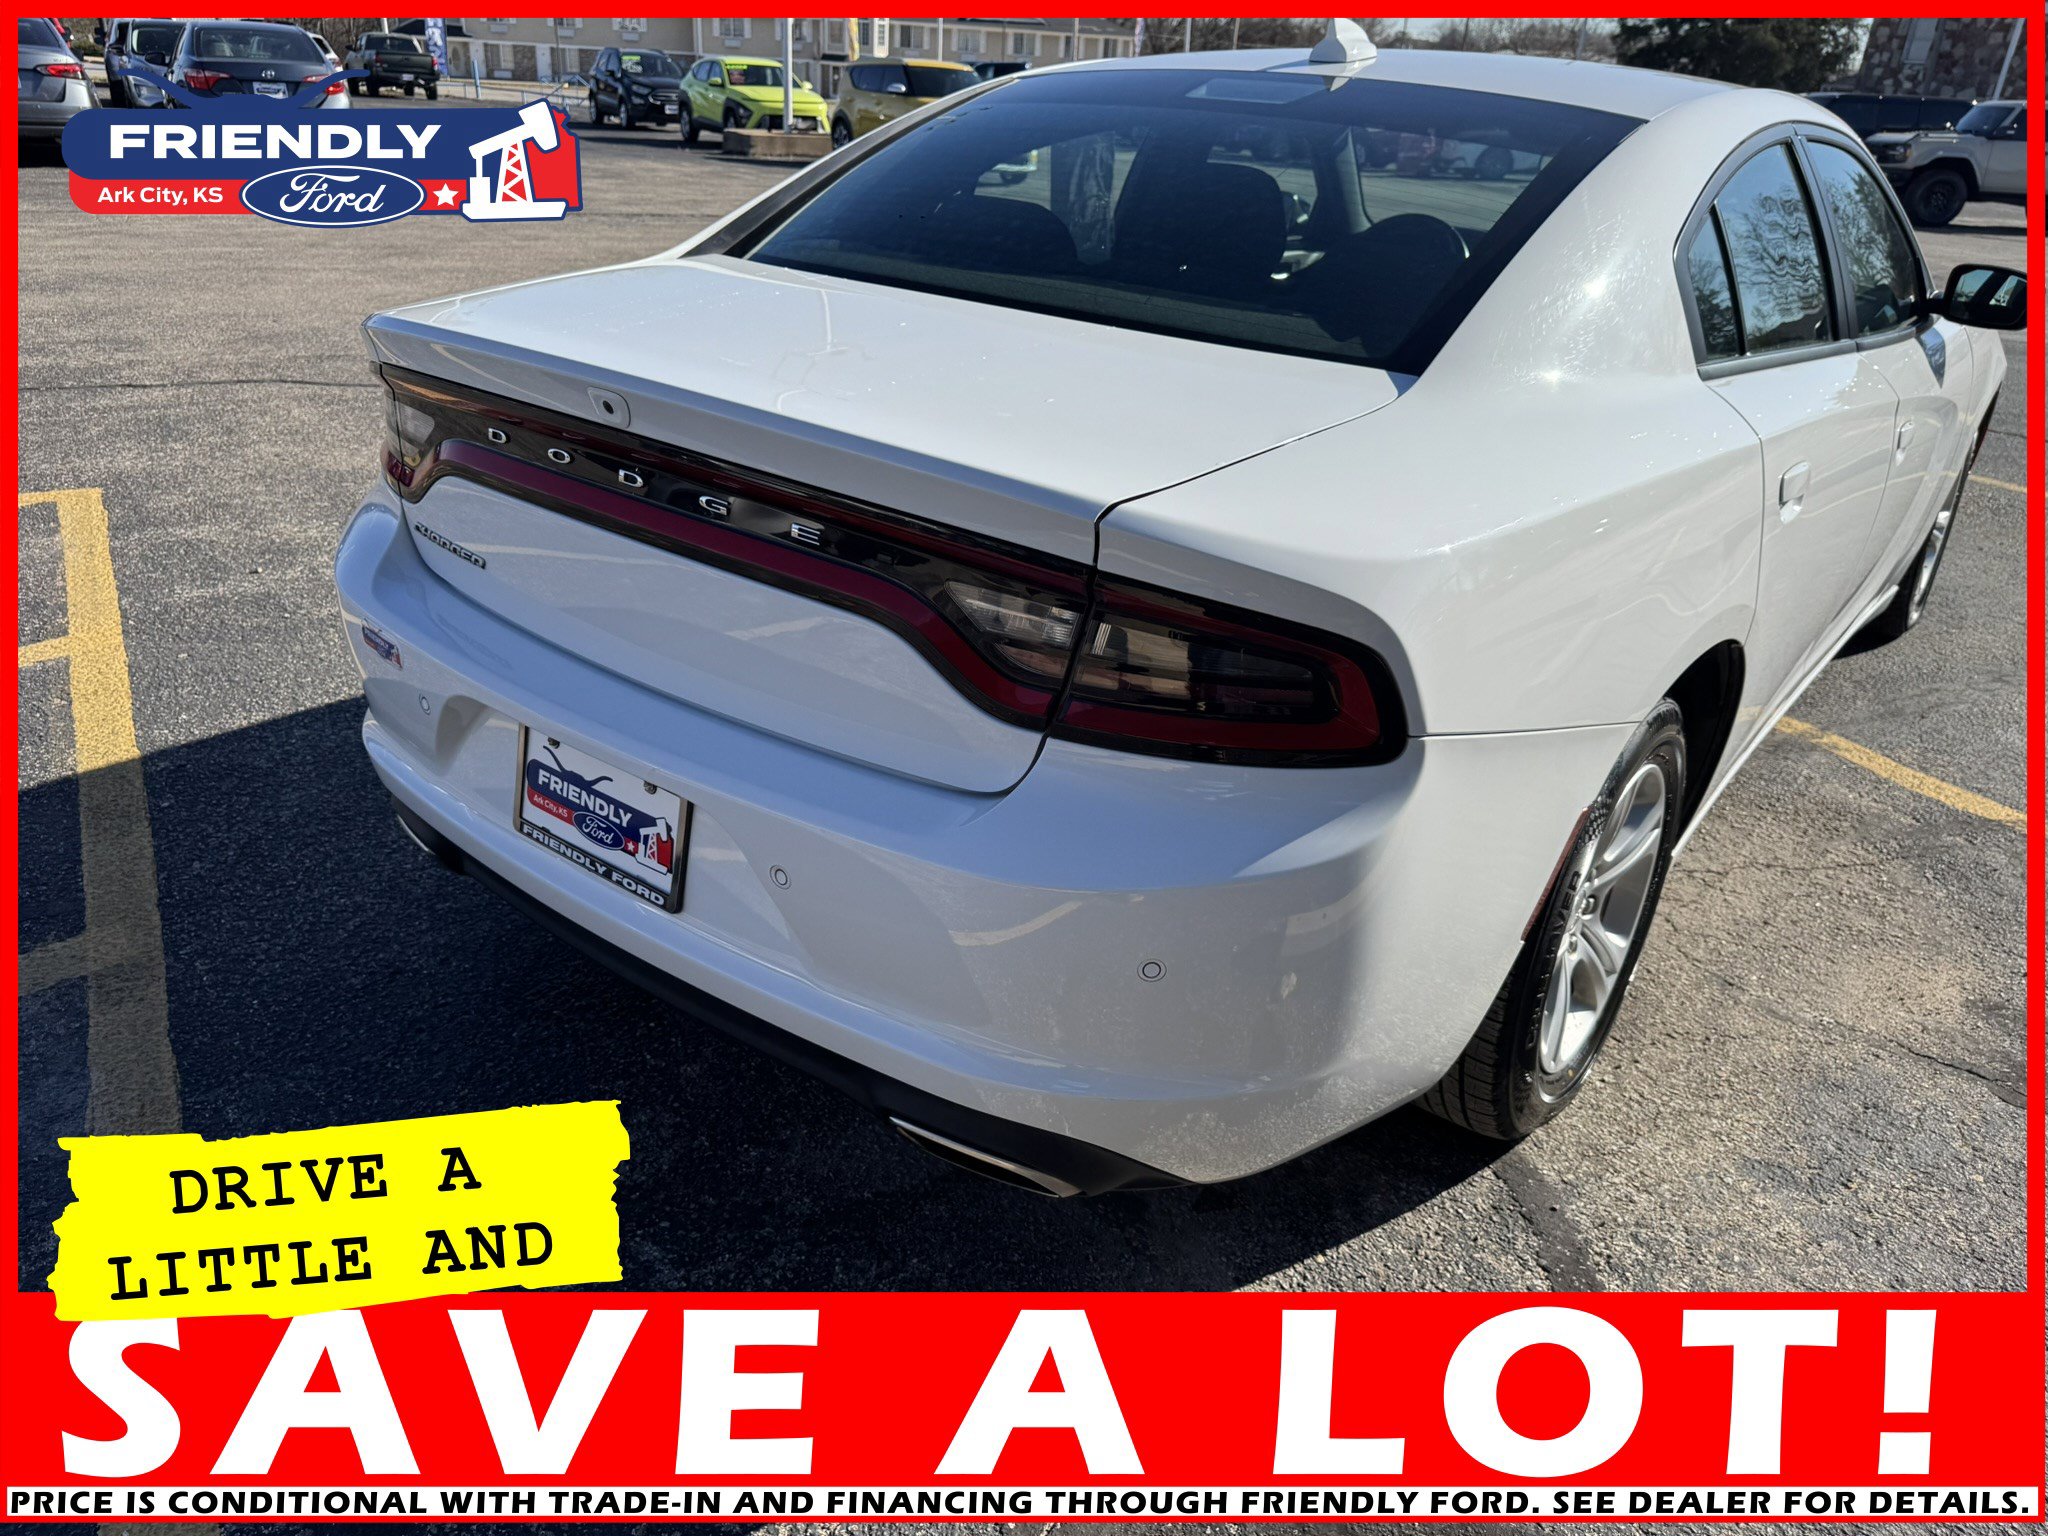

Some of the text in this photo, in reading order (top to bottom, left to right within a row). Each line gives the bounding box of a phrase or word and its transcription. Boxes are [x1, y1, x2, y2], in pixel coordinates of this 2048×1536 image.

[487, 428, 821, 546] DODGE
[534, 794, 545, 806] Ark
[558, 806, 568, 818] KS
[538, 769, 633, 828] FRIENDLY
[582, 817, 615, 845] Ford
[522, 824, 665, 906] FRIENDLY FORD
